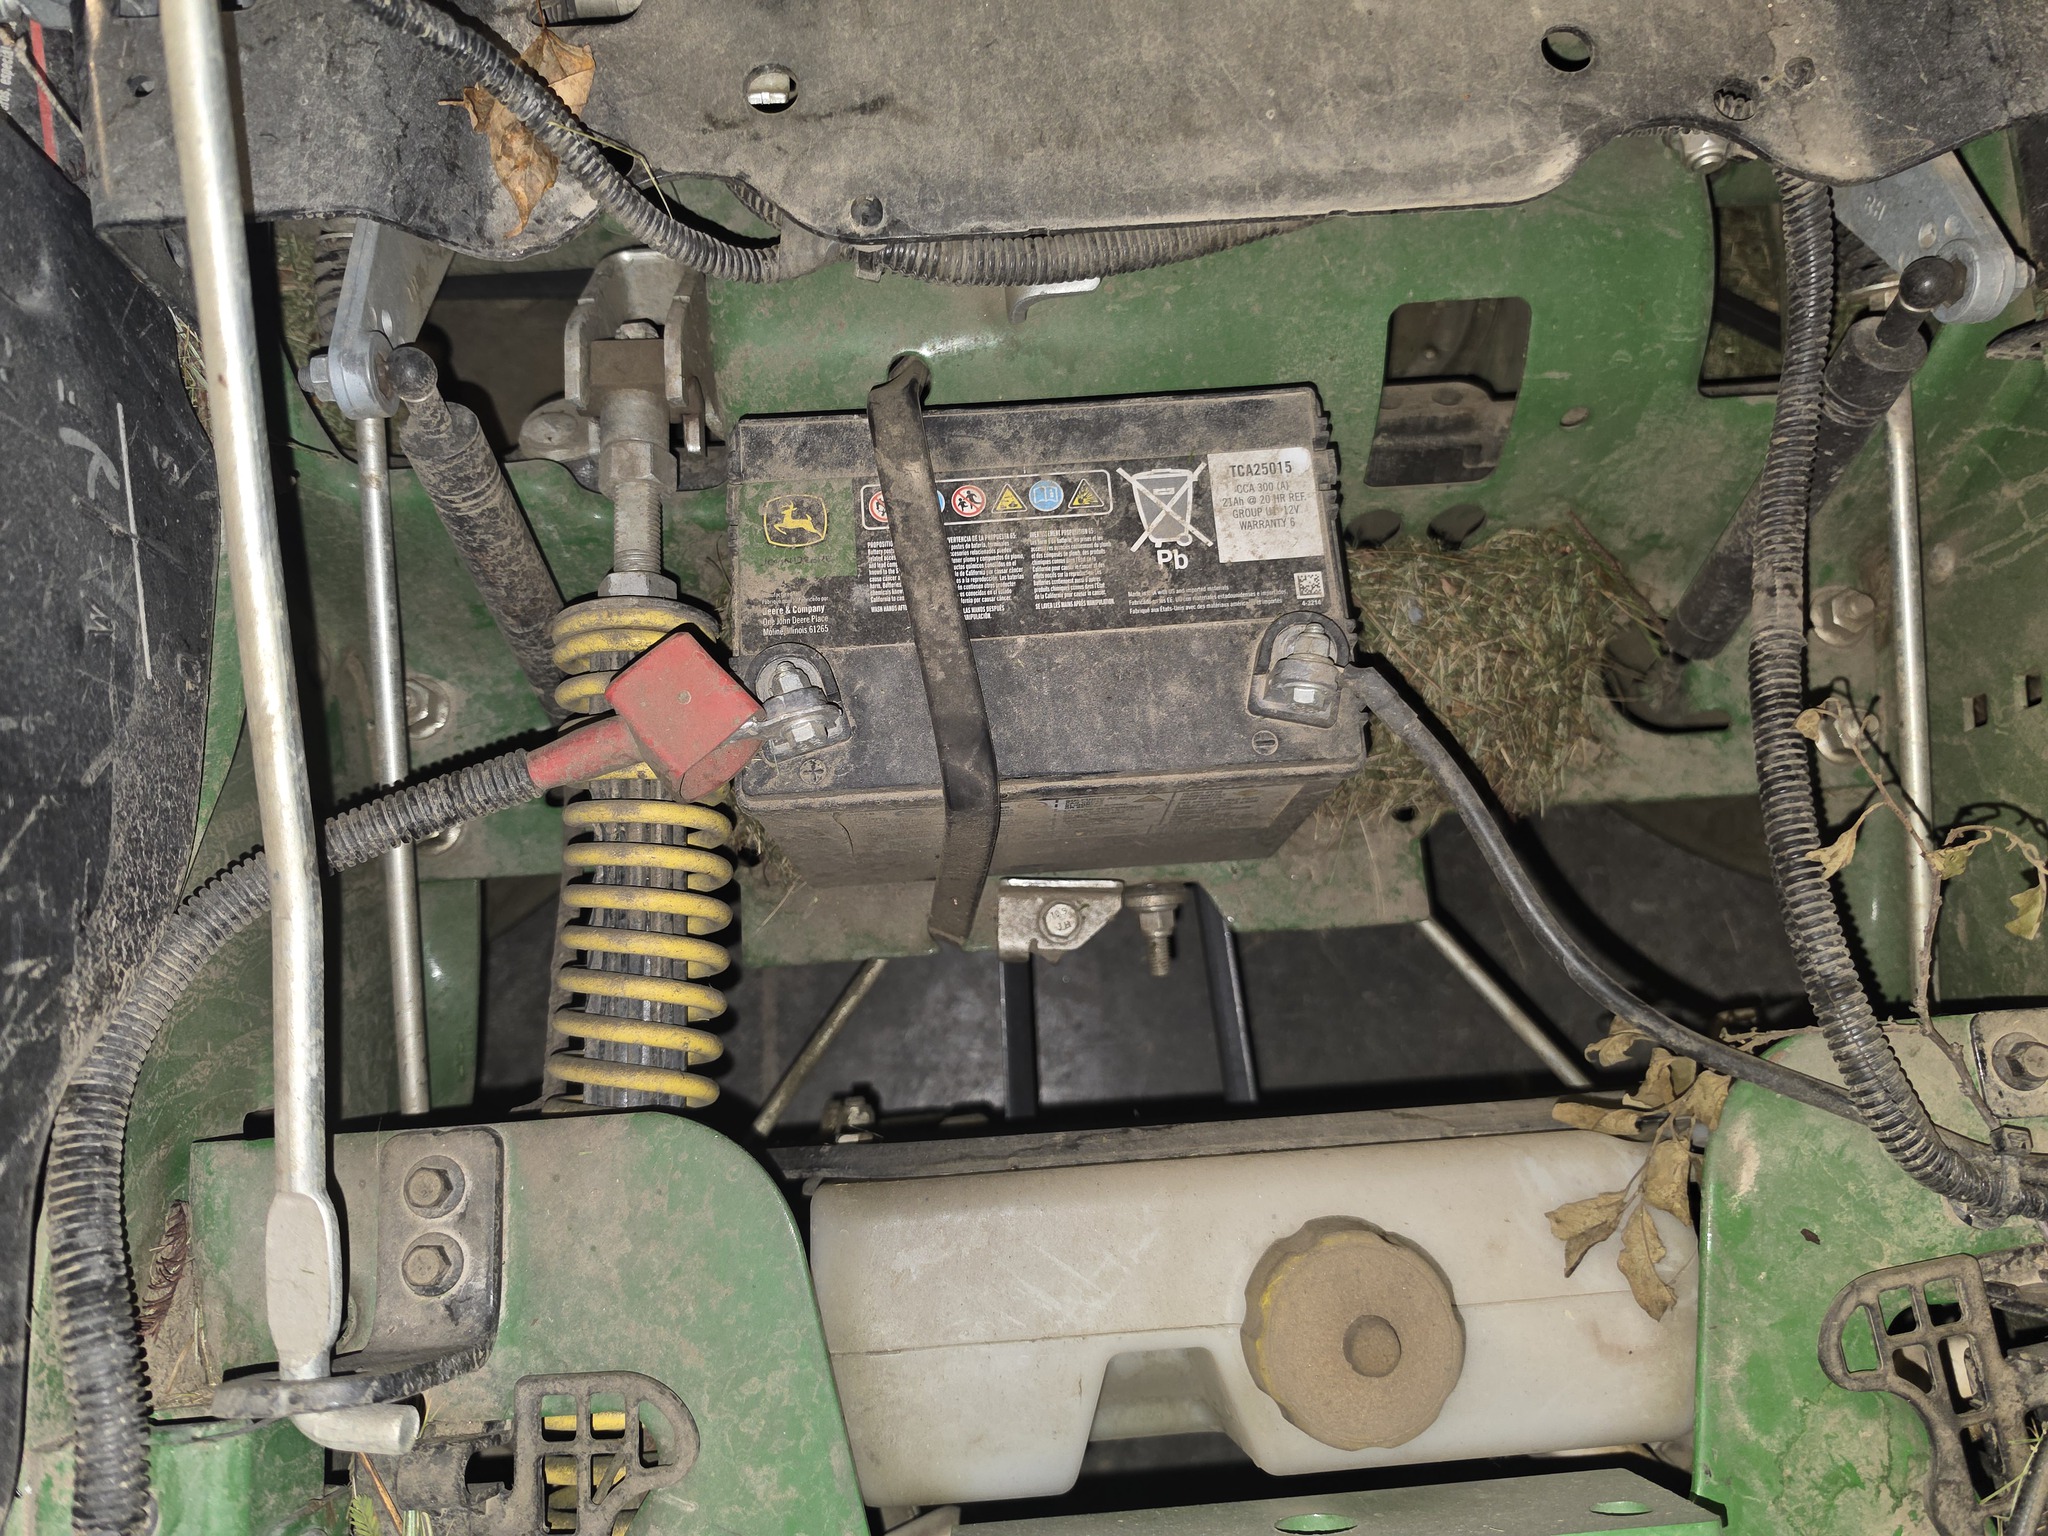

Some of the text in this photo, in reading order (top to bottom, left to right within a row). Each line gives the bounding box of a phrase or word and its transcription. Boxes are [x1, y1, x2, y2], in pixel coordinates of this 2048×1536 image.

[1230, 460, 1292, 478] TCA25015
[1236, 481, 1289, 494] CCA 300 (A)
[1222, 492, 1306, 507] 21Ah @ 20 HR REF.
[1232, 507, 1262, 518] GROUP
[1284, 504, 1300, 514] 12V
[1239, 517, 1296, 530] WARRANTY 6
[1156, 549, 1188, 570] Pb
[763, 605, 825, 616] Deere & Company
[792, 616, 810, 624] Deere
[812, 614, 828, 623] Place
[763, 628, 786, 636] Moline,
[809, 624, 828, 634] 61265
